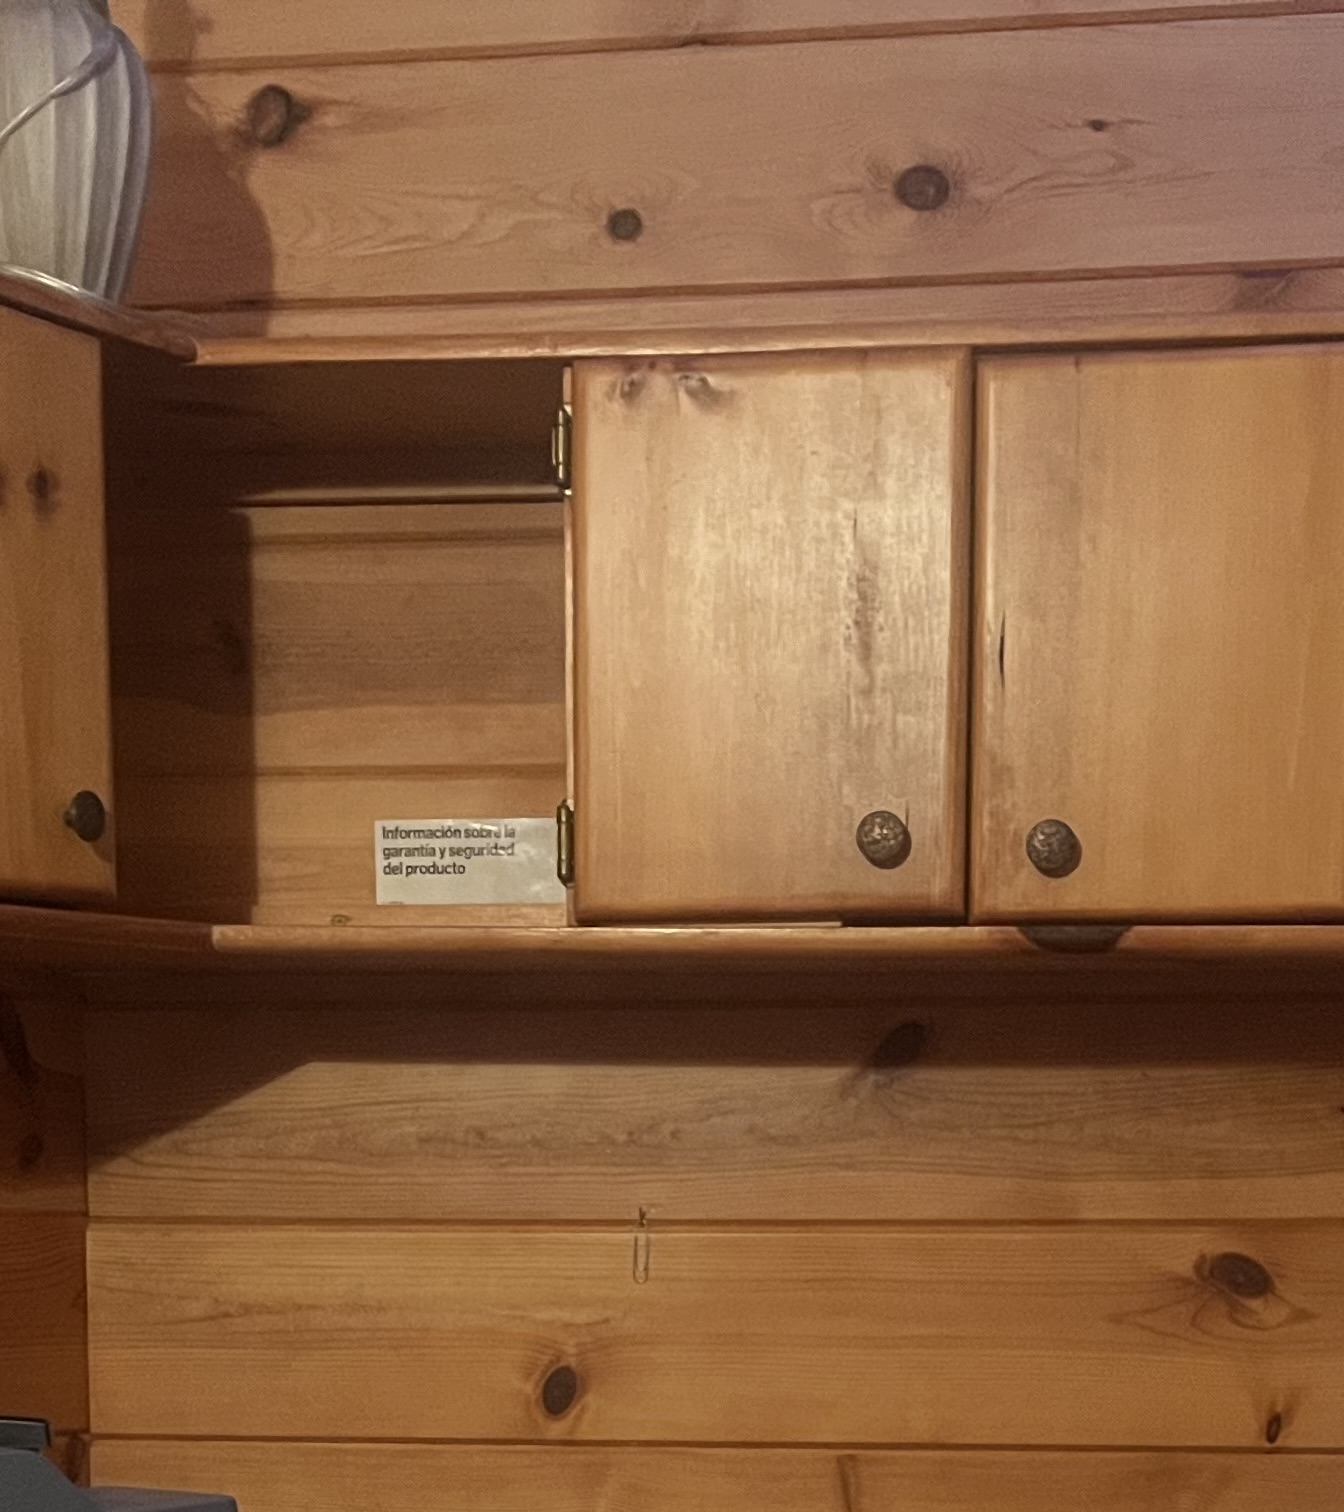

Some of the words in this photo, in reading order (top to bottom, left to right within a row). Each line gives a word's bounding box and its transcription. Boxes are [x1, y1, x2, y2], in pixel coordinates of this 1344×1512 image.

[382, 825, 462, 840] Información
[464, 824, 502, 840] sobre
[503, 824, 517, 839] la
[382, 843, 437, 861] garantía
[438, 846, 446, 860] y
[448, 842, 516, 860] seguridad
[383, 862, 403, 876] del
[405, 861, 467, 877] producto
